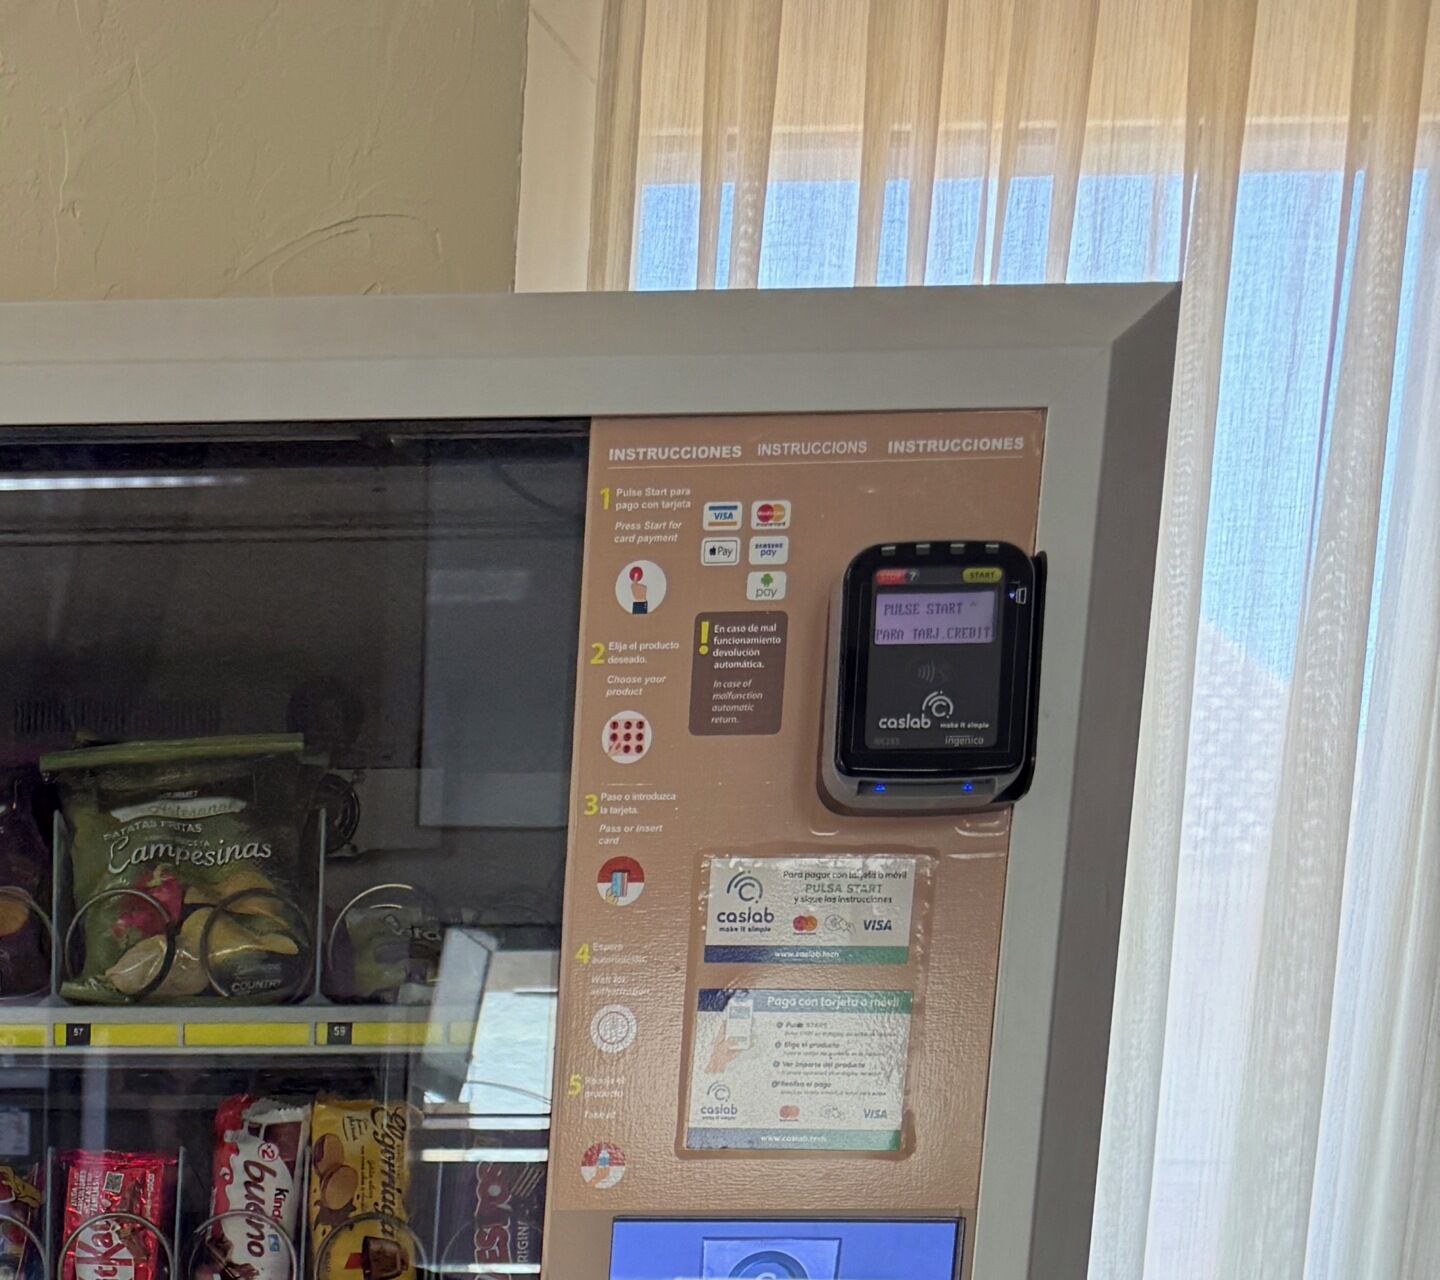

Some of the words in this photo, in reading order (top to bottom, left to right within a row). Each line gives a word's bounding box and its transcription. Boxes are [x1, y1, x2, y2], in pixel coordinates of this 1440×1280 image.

[609, 446, 742, 461] INSTRUCCIONES
[758, 440, 867, 456] INSTRUCCIONS
[887, 437, 1024, 453] INSTRUCCIONES
[616, 488, 642, 497] Pulse
[645, 488, 667, 497] Start
[670, 488, 691, 497] para
[600, 488, 610, 510] 1
[616, 501, 639, 512] pago
[714, 512, 733, 520] VISA
[615, 521, 641, 531] Press
[644, 521, 666, 530] Start
[614, 534, 635, 543] card
[638, 533, 678, 544] payment
[718, 546, 733, 557] Pay
[884, 604, 919, 616] PULSE
[926, 603, 963, 615] START
[760, 624, 776, 632] mal
[714, 637, 781, 645] funcionamiento
[639, 642, 679, 652] producto
[590, 643, 605, 664] 2
[607, 675, 642, 684] Choose
[606, 687, 642, 697] product
[879, 714, 931, 729] caslab
[600, 792, 622, 801] Pase
[632, 792, 676, 801] introduzca
[584, 794, 598, 816] 3
[599, 825, 621, 833] Pass
[108, 839, 272, 875] Campesinas
[784, 871, 802, 879] Para
[804, 871, 830, 880] pagar
[885, 871, 907, 879] móvil
[805, 884, 842, 893] PULSA
[847, 883, 882, 893] START
[838, 895, 892, 903] instrucciones
[717, 907, 775, 924] caslab
[863, 920, 892, 931] VISA
[575, 943, 590, 965] 4
[768, 997, 796, 1008] Paga
[799, 998, 818, 1007] con
[821, 996, 857, 1008] tarjeta
[333, 1026, 346, 1036] 59
[701, 1103, 737, 1115] caslab
[863, 1108, 887, 1119] VISA
[244, 1160, 276, 1258] bueno
